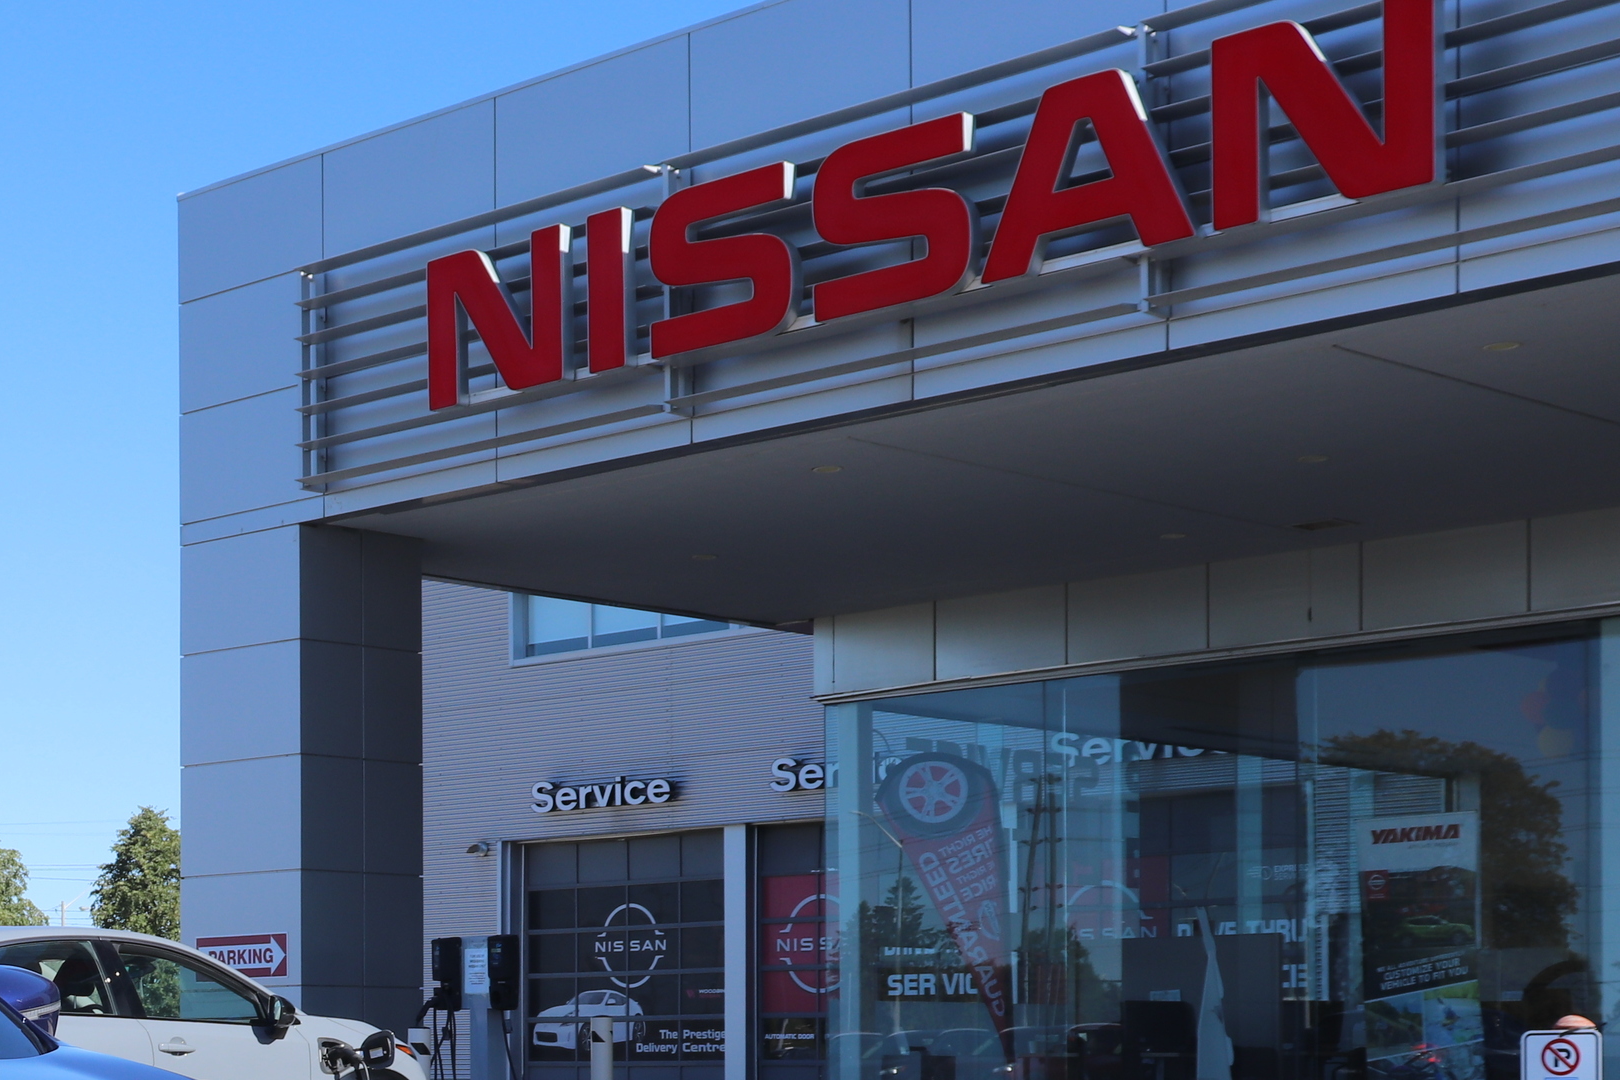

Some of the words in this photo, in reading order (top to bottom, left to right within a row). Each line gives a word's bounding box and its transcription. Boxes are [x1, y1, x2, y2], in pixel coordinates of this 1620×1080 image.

[427, 0, 1438, 411] NISSAN
[531, 776, 671, 813] Service
[1371, 823, 1460, 845] YAKIMA
[595, 939, 666, 953] NISSAN
[777, 937, 839, 952] NISS
[1380, 976, 1417, 991] VEHICLE
[1418, 973, 1431, 983] TO
[1448, 965, 1469, 977] YOU
[1383, 963, 1433, 981] CUSTOMIZE
[1435, 957, 1461, 971] YOUR
[887, 973, 978, 996] SERVIC
[659, 1029, 678, 1039] The
[683, 1028, 725, 1041] Prestige
[636, 1042, 678, 1054] Delivery
[682, 1042, 725, 1052] Centre
